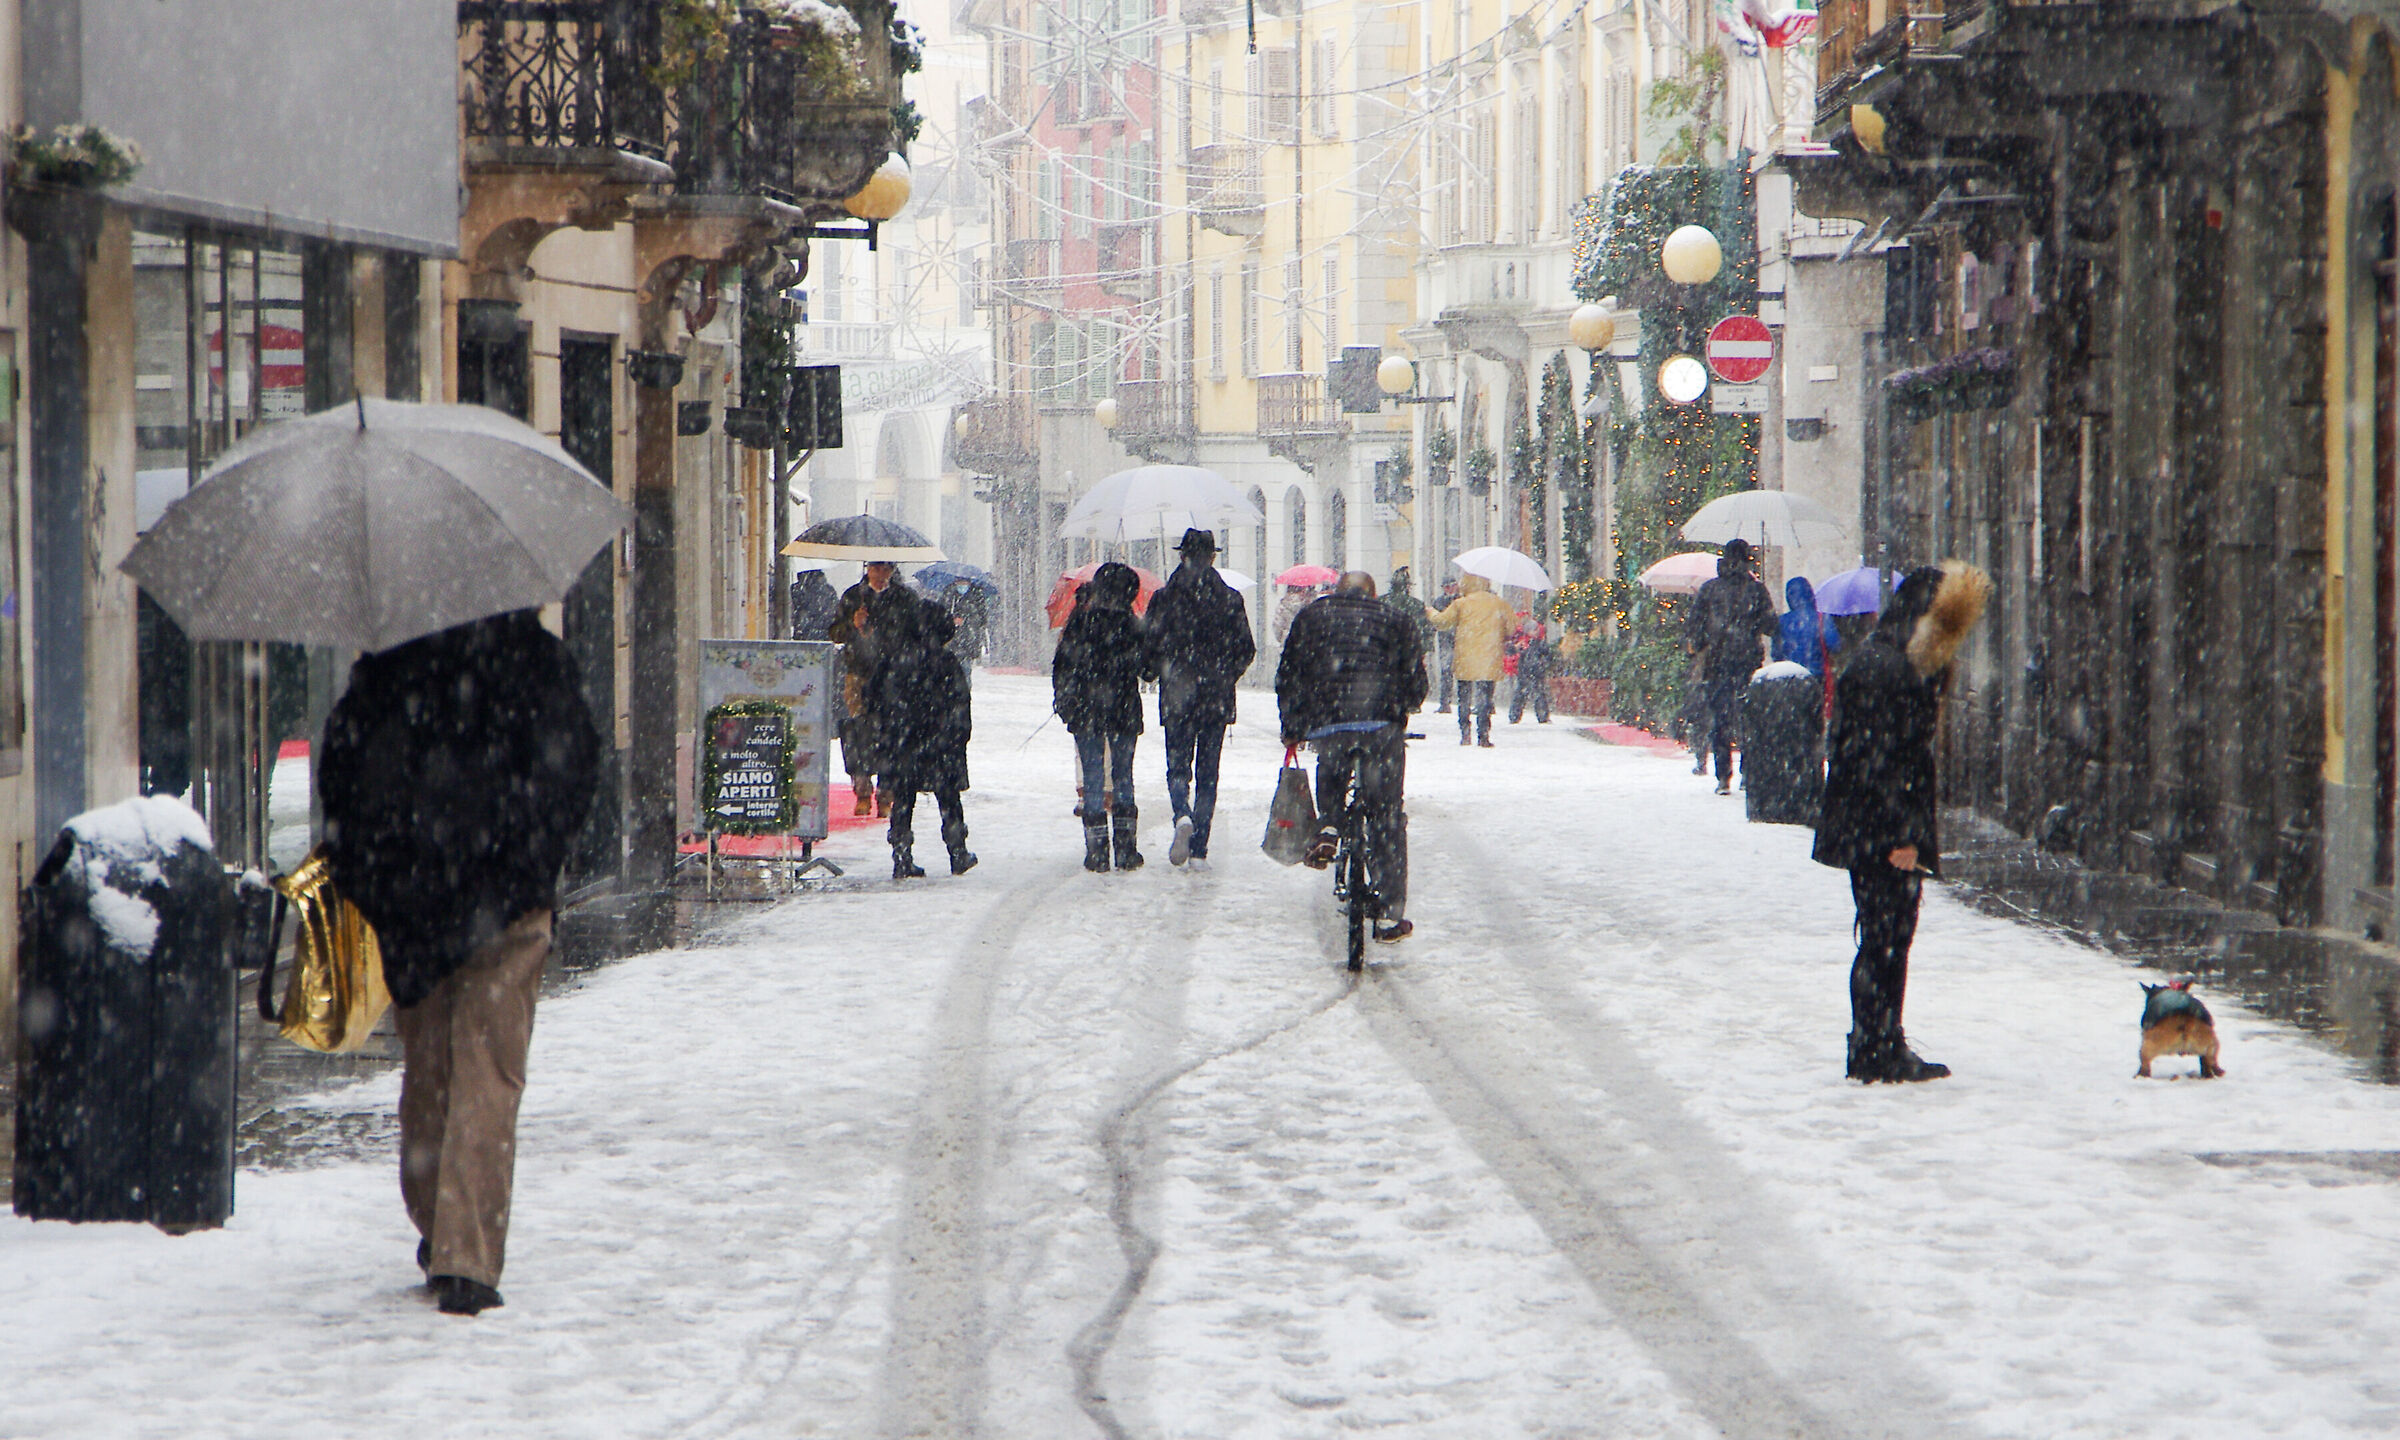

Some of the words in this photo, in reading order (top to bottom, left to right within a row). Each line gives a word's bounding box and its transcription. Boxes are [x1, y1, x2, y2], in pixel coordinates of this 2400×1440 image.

[754, 724, 776, 732] cere
[746, 736, 783, 745] candele
[730, 749, 759, 759] molto
[722, 772, 774, 785] SIAMO
[718, 785, 776, 799] APERTI
[747, 801, 779, 809] interno
[746, 809, 776, 817] cortile
